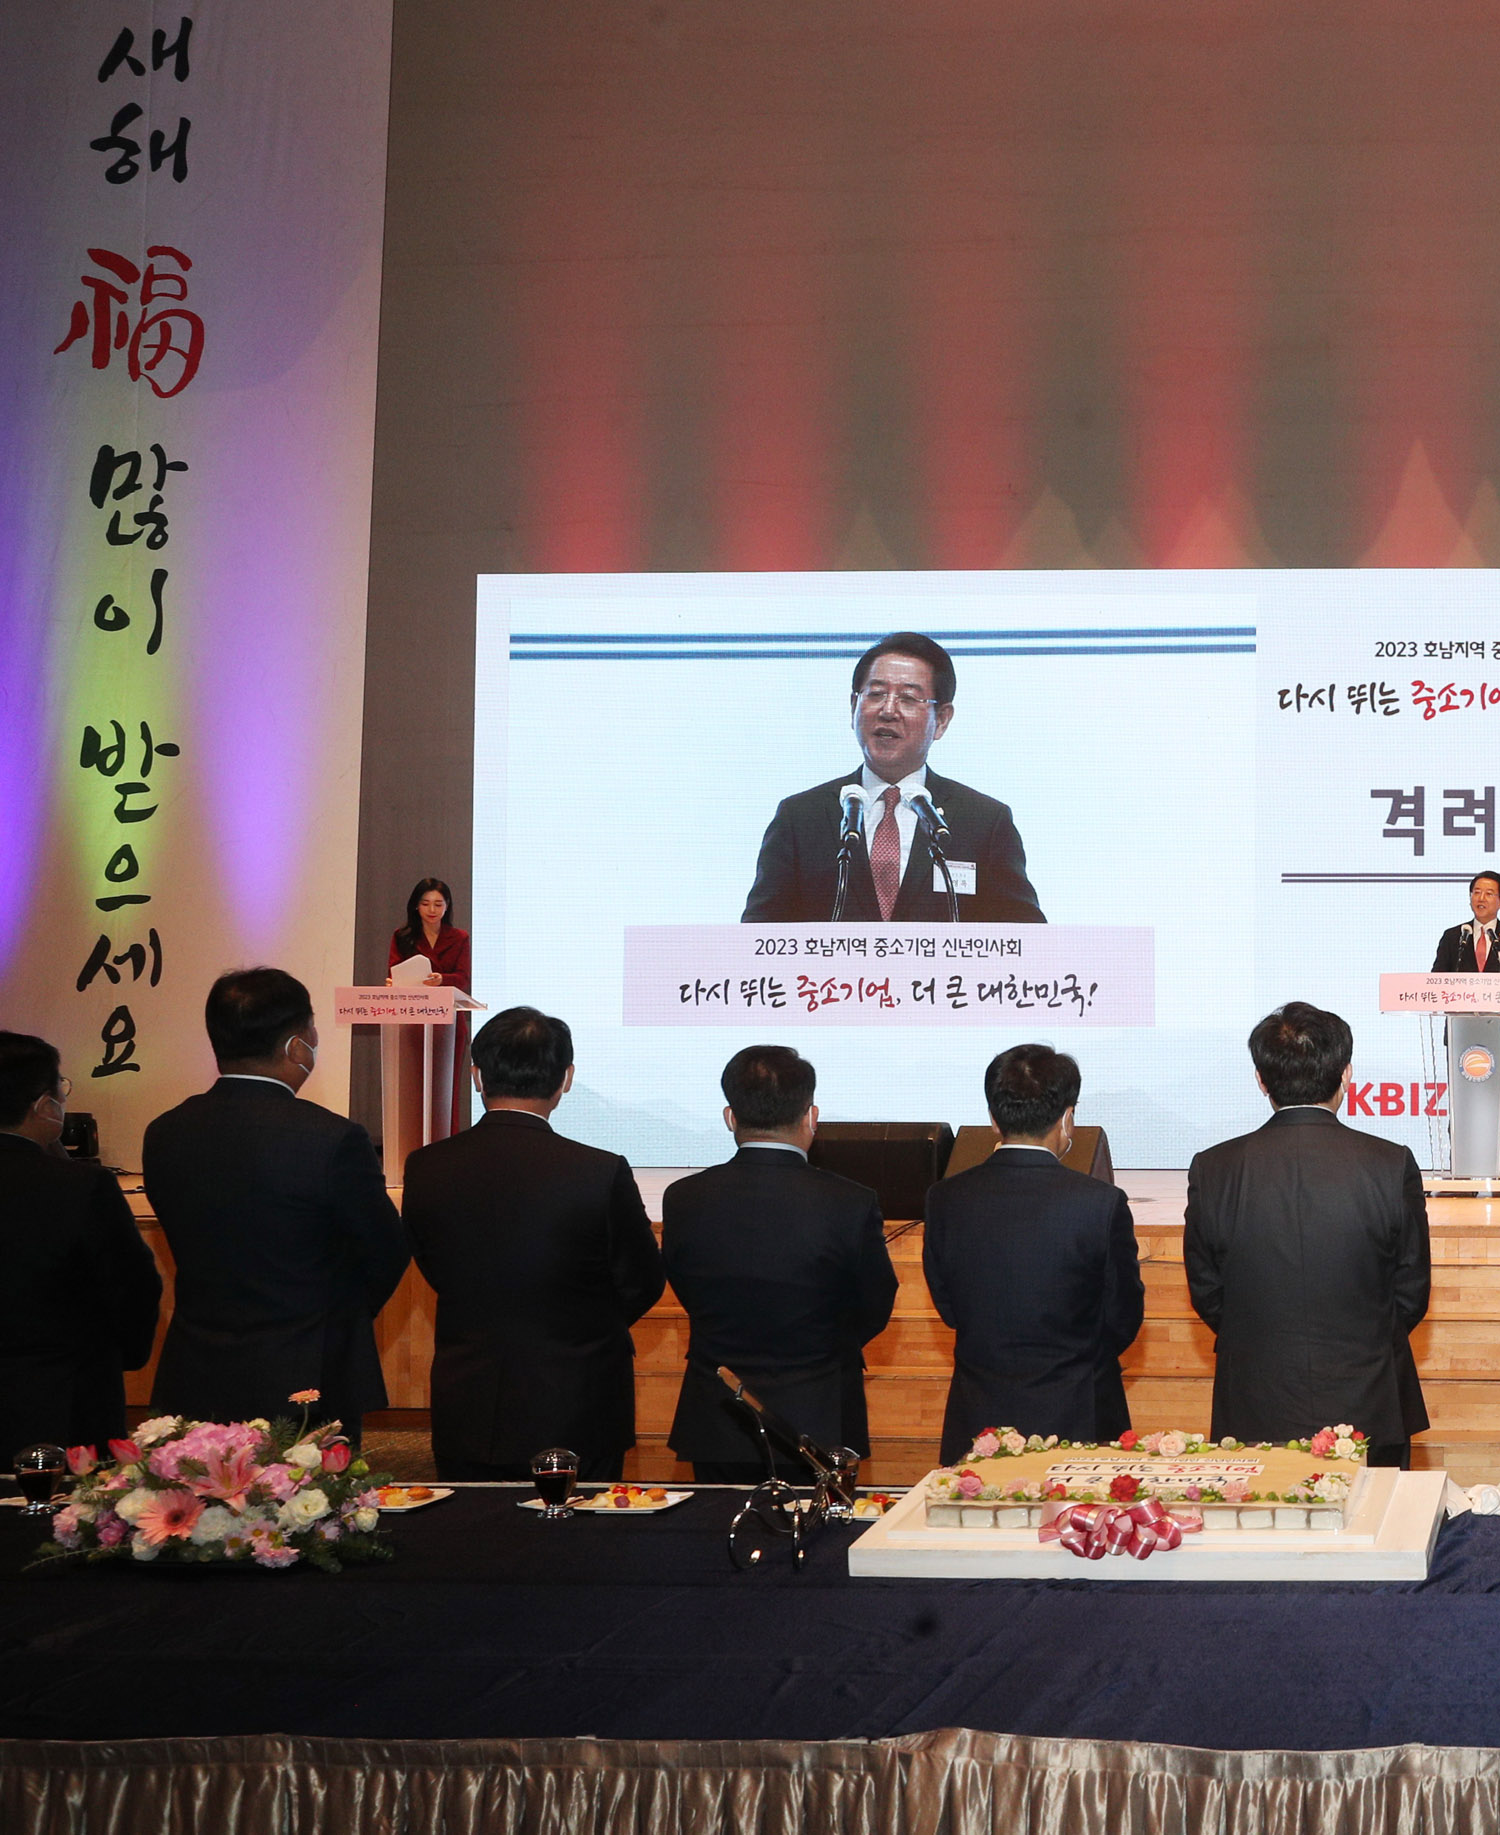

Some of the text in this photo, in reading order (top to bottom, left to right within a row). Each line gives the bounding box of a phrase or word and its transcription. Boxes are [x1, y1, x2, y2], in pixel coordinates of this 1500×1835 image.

[54, 17, 205, 1078] 새해 福 많이 받으세요
[1375, 641, 1418, 658] 2023
[1423, 640, 1485, 660] 호남지역
[1277, 682, 1336, 714] 다시
[1347, 681, 1400, 717] 뛰는
[755, 937, 1022, 958] 2023 호남지역 중소기업 신년인사회
[679, 974, 1099, 1017] 다시 뛰는 중소기업, 더 큰 대한민국!
[1399, 991, 1418, 1002] 다시
[1420, 991, 1438, 1004] 뛰는
[1482, 991, 1492, 1002] 더
[1347, 1082, 1448, 1116] KBIZ
